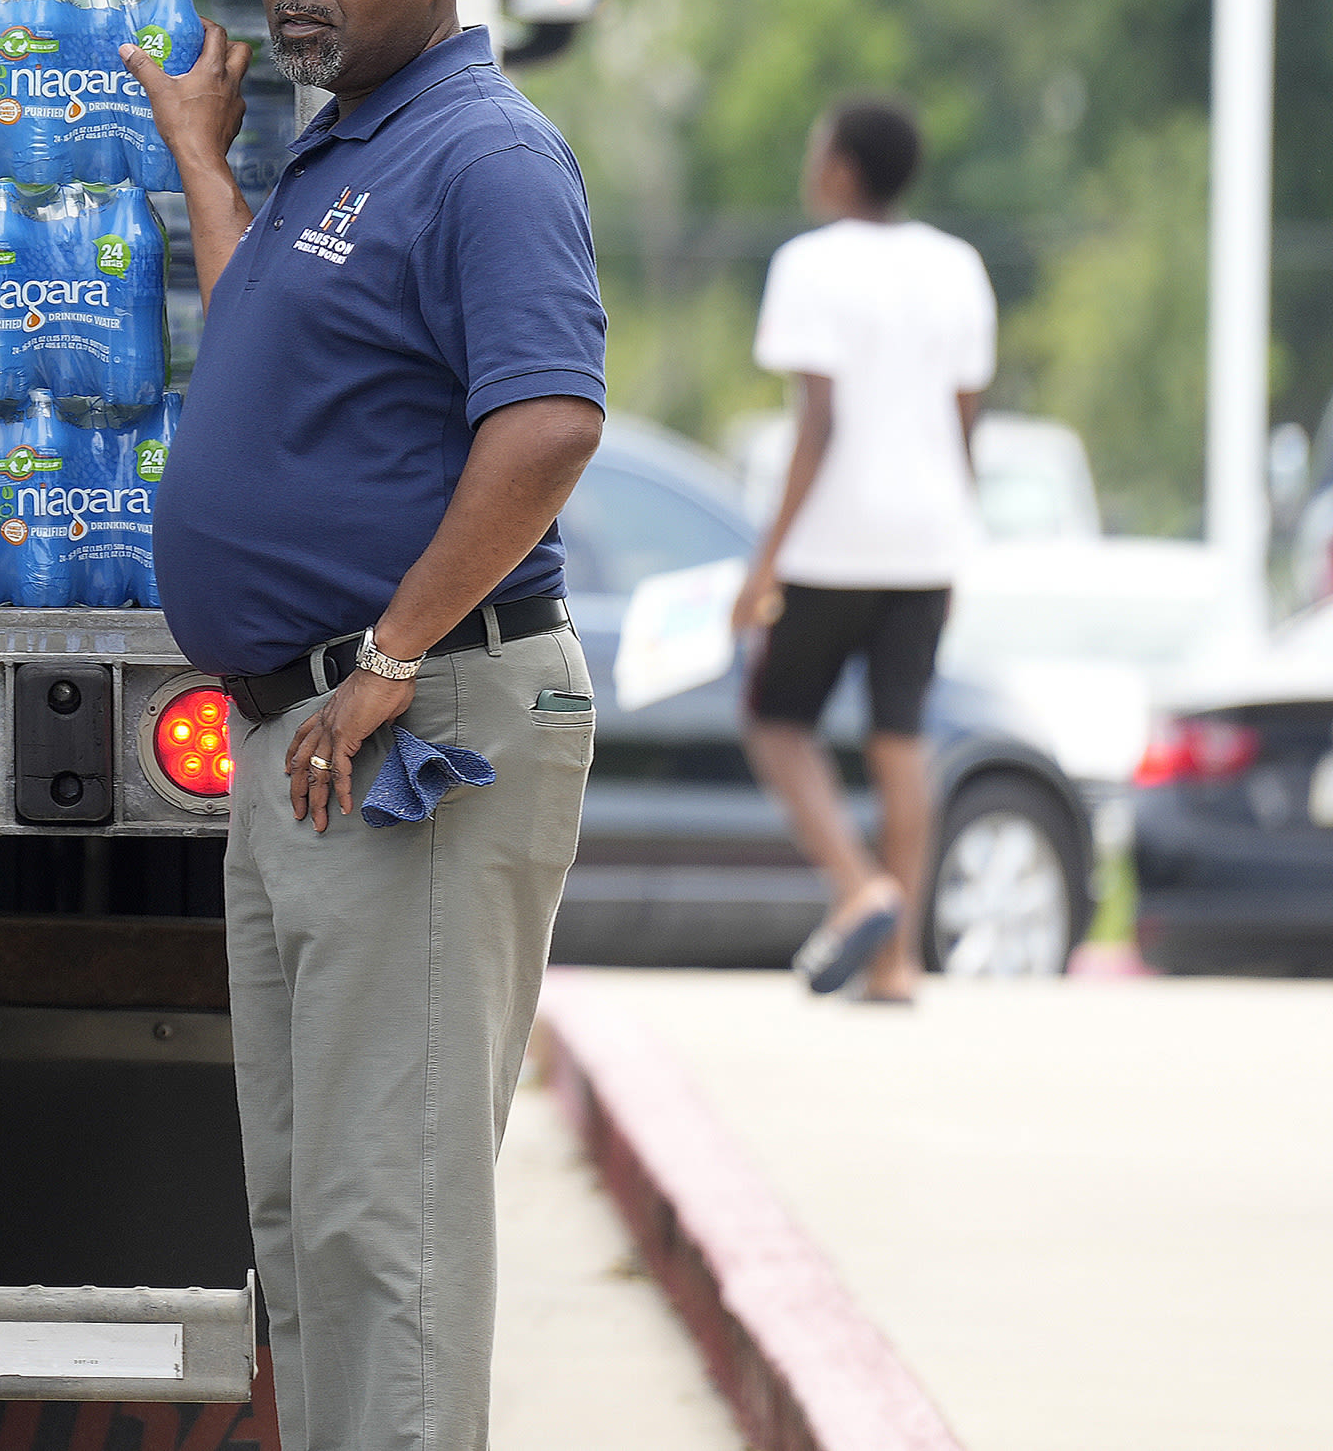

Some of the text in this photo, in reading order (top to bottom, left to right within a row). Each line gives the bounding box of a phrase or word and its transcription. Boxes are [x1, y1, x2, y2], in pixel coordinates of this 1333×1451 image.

[141, 34, 165, 50] 24
[24, 106, 64, 118] PURIFIED
[88, 102, 130, 115] DRINKING
[131, 105, 153, 118] WATE
[299, 228, 355, 255] HOUSTON
[100, 244, 124, 260] 24
[48, 313, 91, 325] DRINKING
[91, 316, 121, 329] WATER
[141, 449, 166, 466] 24
[17, 483, 151, 542] niagara
[31, 521, 153, 538] PURIFIED DRINKING WAT
